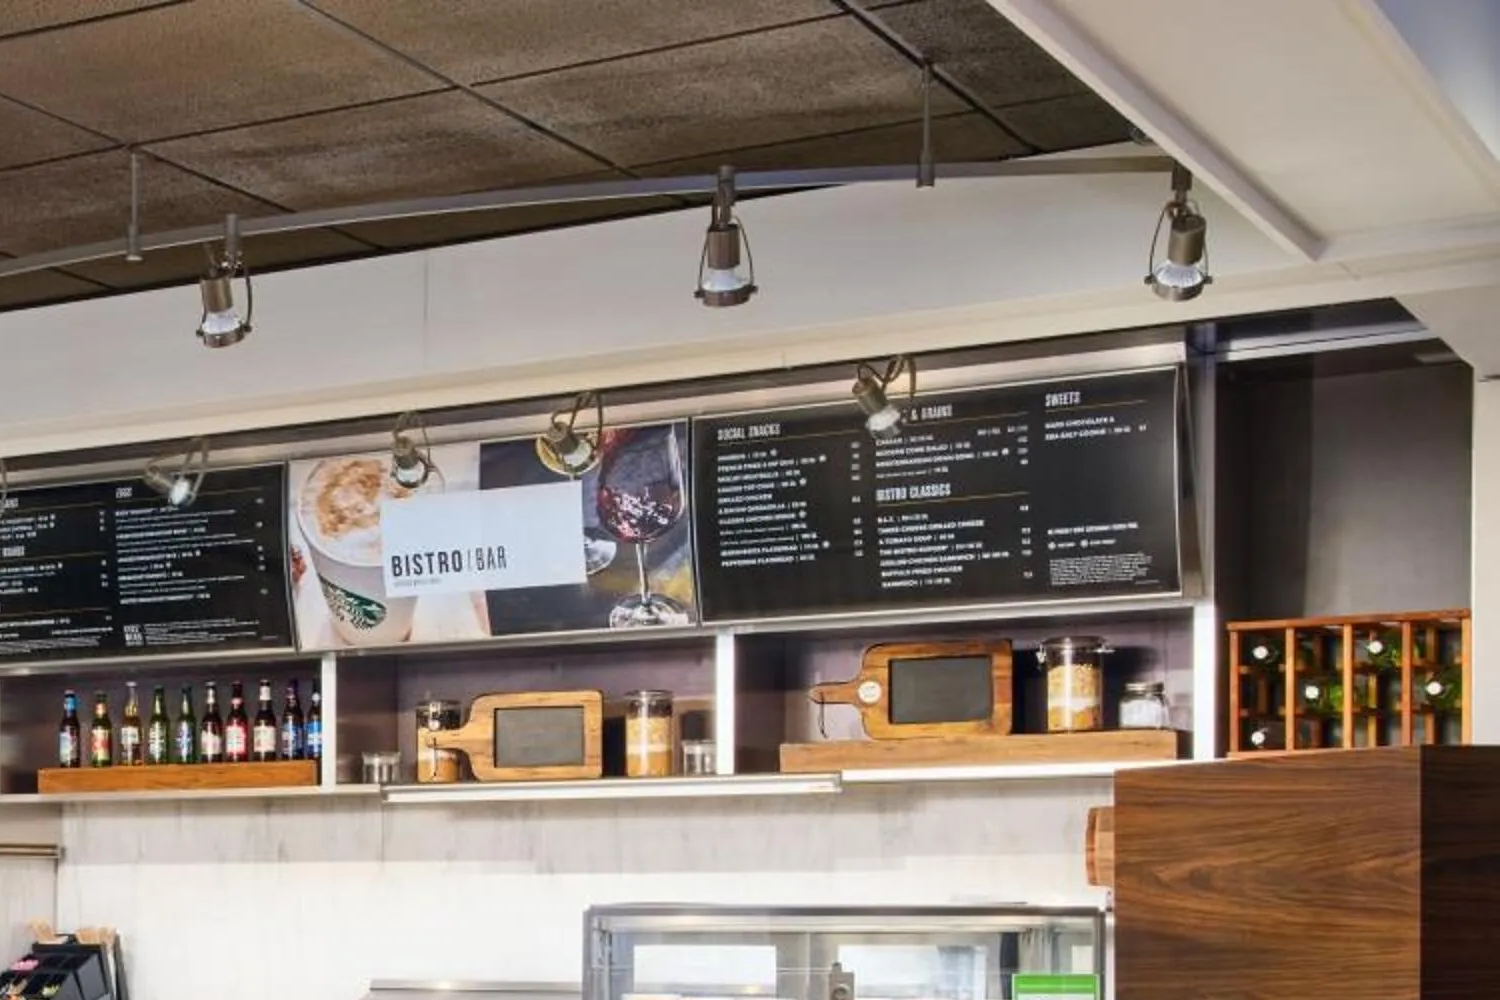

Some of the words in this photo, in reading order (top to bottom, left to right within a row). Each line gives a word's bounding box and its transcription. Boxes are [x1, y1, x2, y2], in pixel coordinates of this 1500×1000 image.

[1045, 391, 1080, 407] SWEETS
[717, 427, 745, 441] SOCIAL
[875, 487, 907, 501] BISTRO
[909, 483, 951, 498] CLASSICS
[391, 549, 463, 577] BISTRO
[475, 545, 507, 571] BAR
